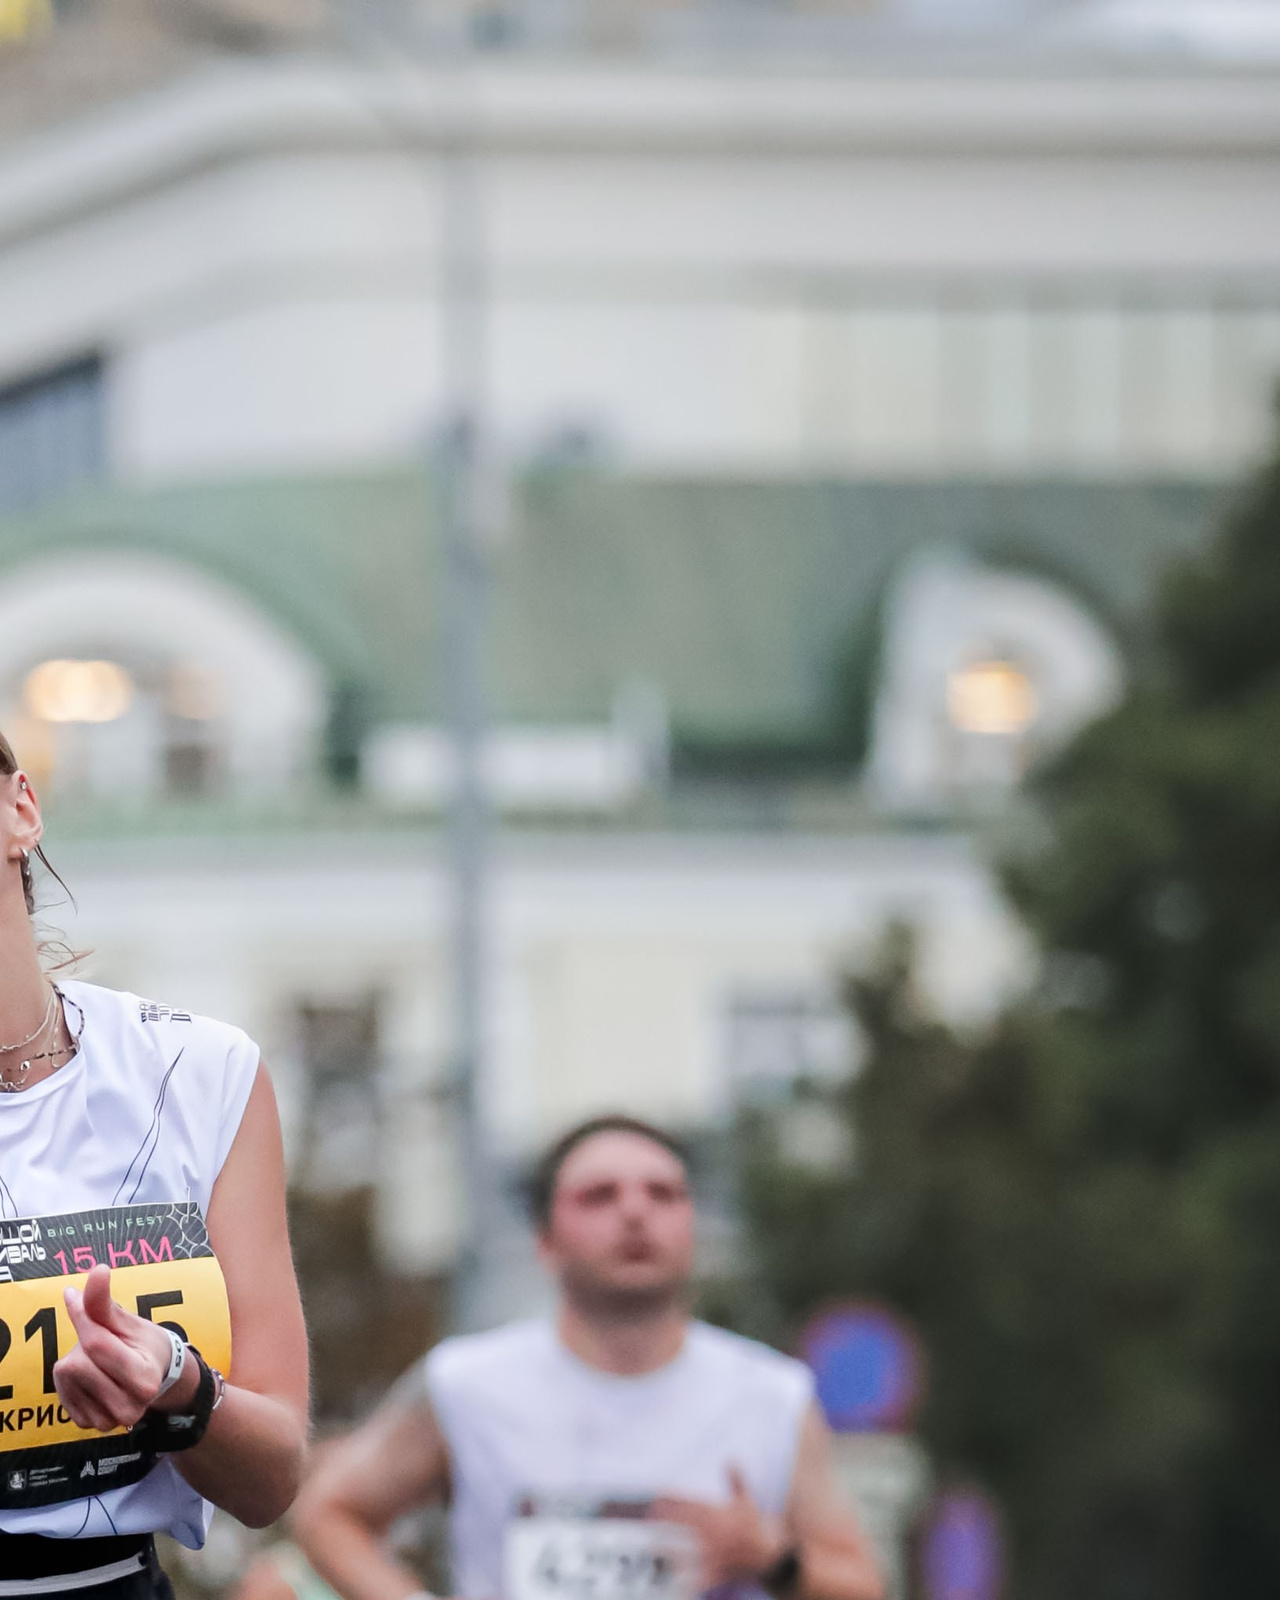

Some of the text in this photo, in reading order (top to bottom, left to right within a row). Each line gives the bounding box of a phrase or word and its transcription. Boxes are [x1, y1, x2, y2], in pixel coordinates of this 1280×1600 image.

[46, 1215, 163, 1238] BIG RUN FEST
[53, 1245, 98, 1275] 15
